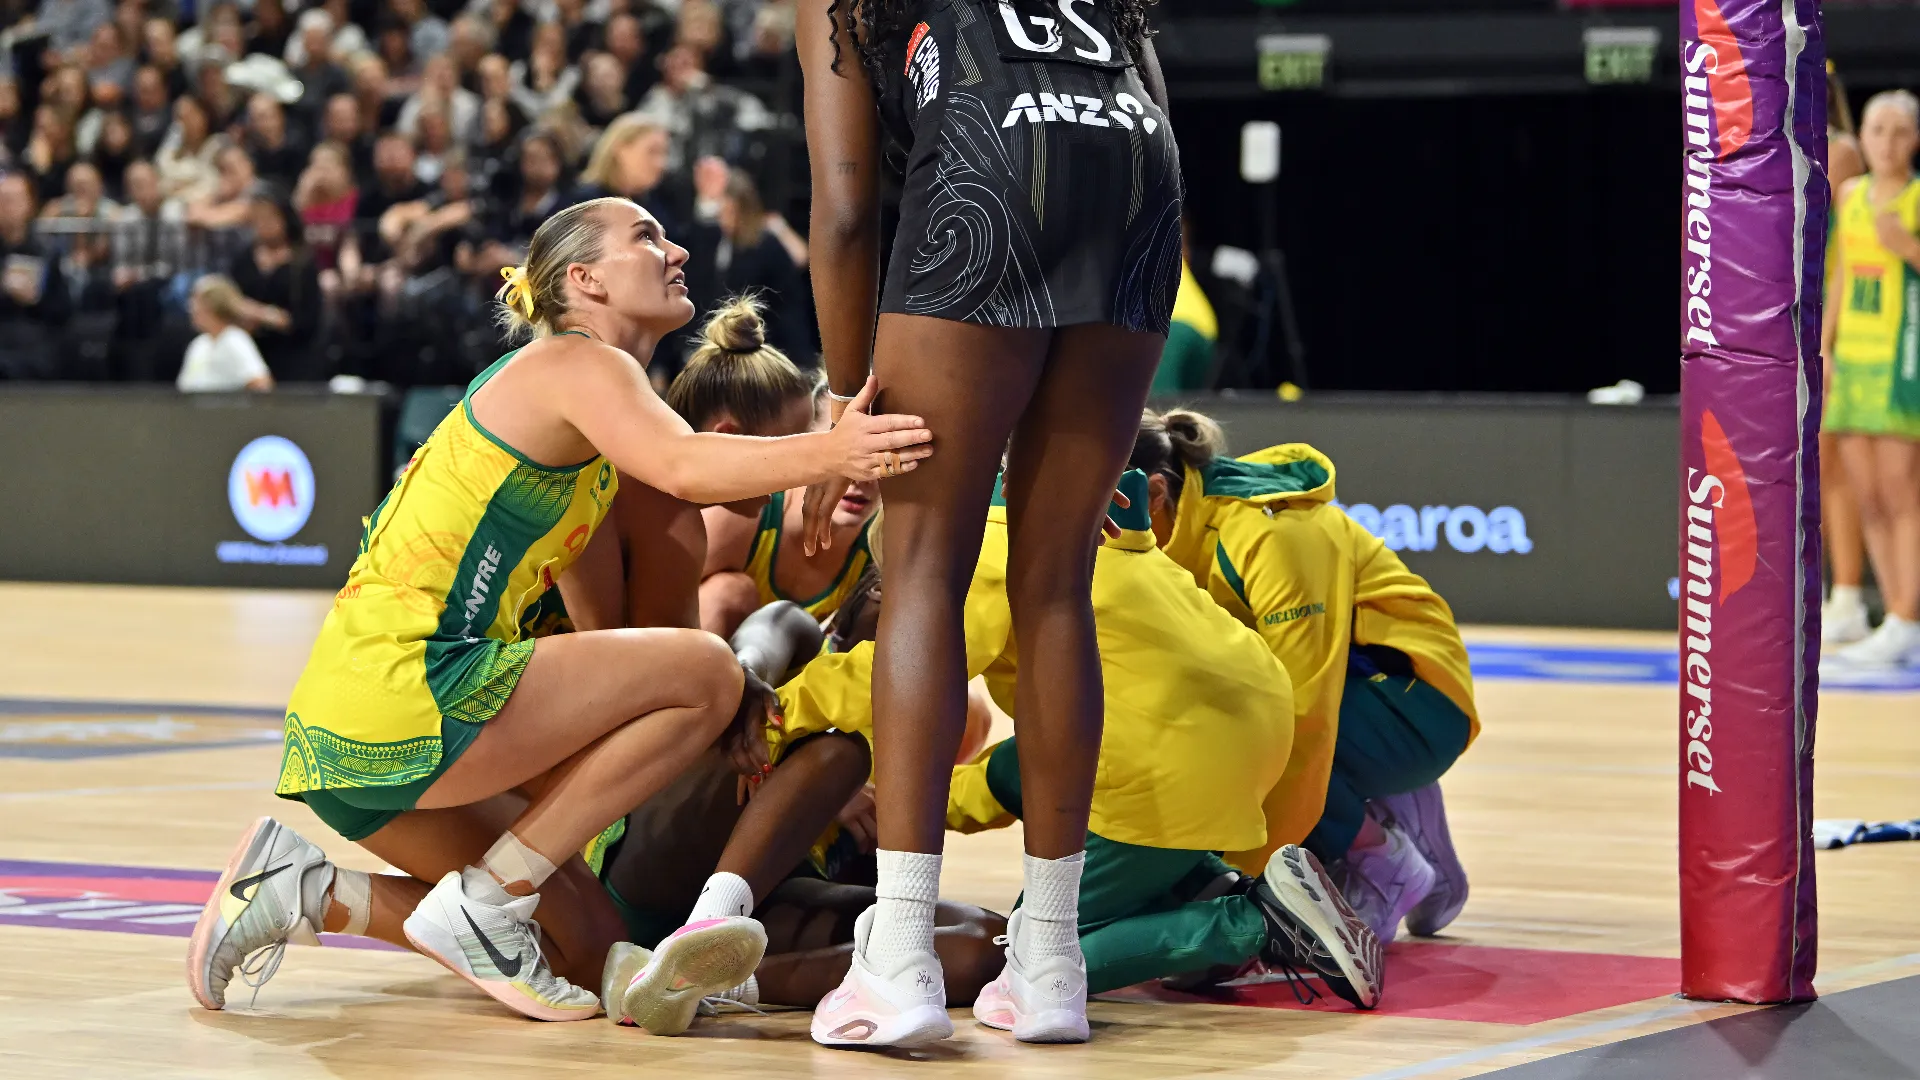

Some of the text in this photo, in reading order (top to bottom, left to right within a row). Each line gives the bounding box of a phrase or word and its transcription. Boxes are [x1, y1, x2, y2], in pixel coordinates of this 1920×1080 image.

[998, 0, 1112, 62] GS
[1001, 92, 1110, 128] ANZ
[1684, 39, 1720, 351] Summerset
[1328, 497, 1533, 554] earoa
[1686, 467, 1724, 796] Summerset
